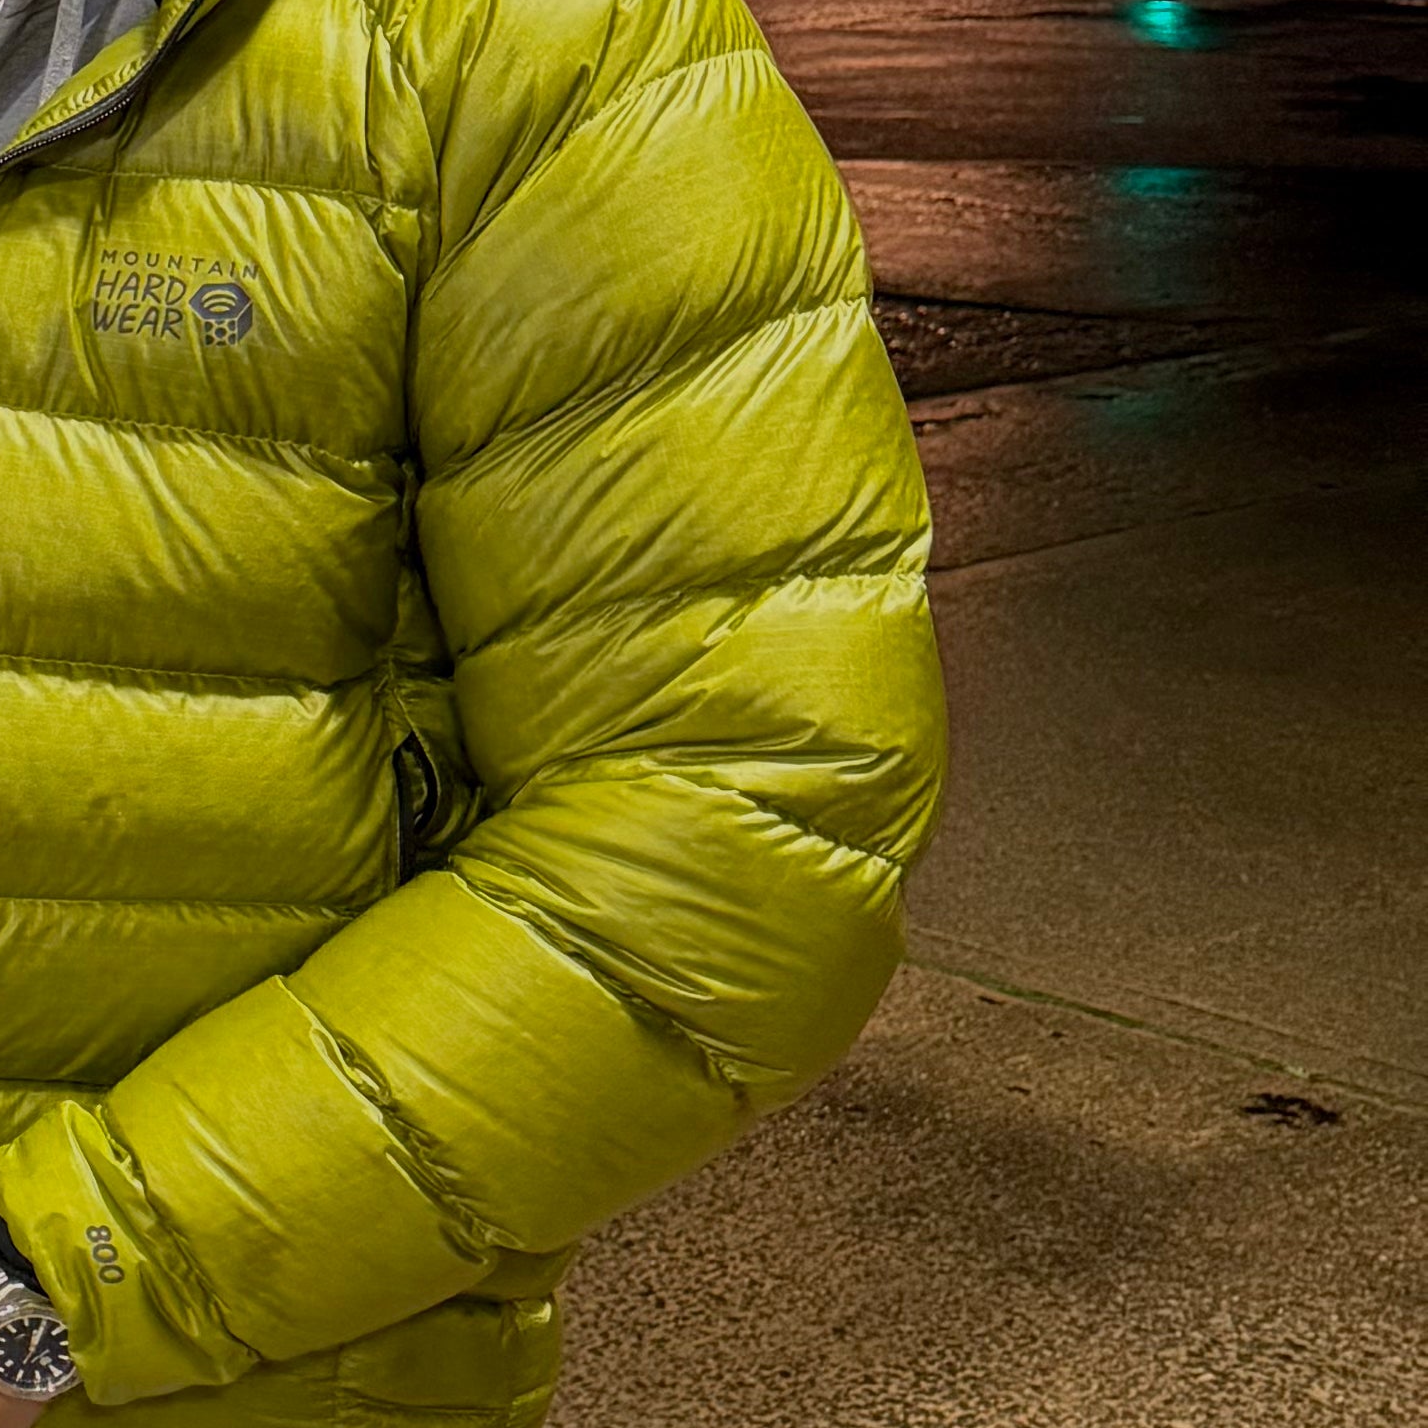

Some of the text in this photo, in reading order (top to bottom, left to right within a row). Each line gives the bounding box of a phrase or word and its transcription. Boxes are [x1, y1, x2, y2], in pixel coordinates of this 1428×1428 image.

[100, 249, 260, 280] MOUNTAIN
[95, 269, 187, 306] HARD
[93, 301, 184, 340] WEAR
[85, 1224, 126, 1284] 800
